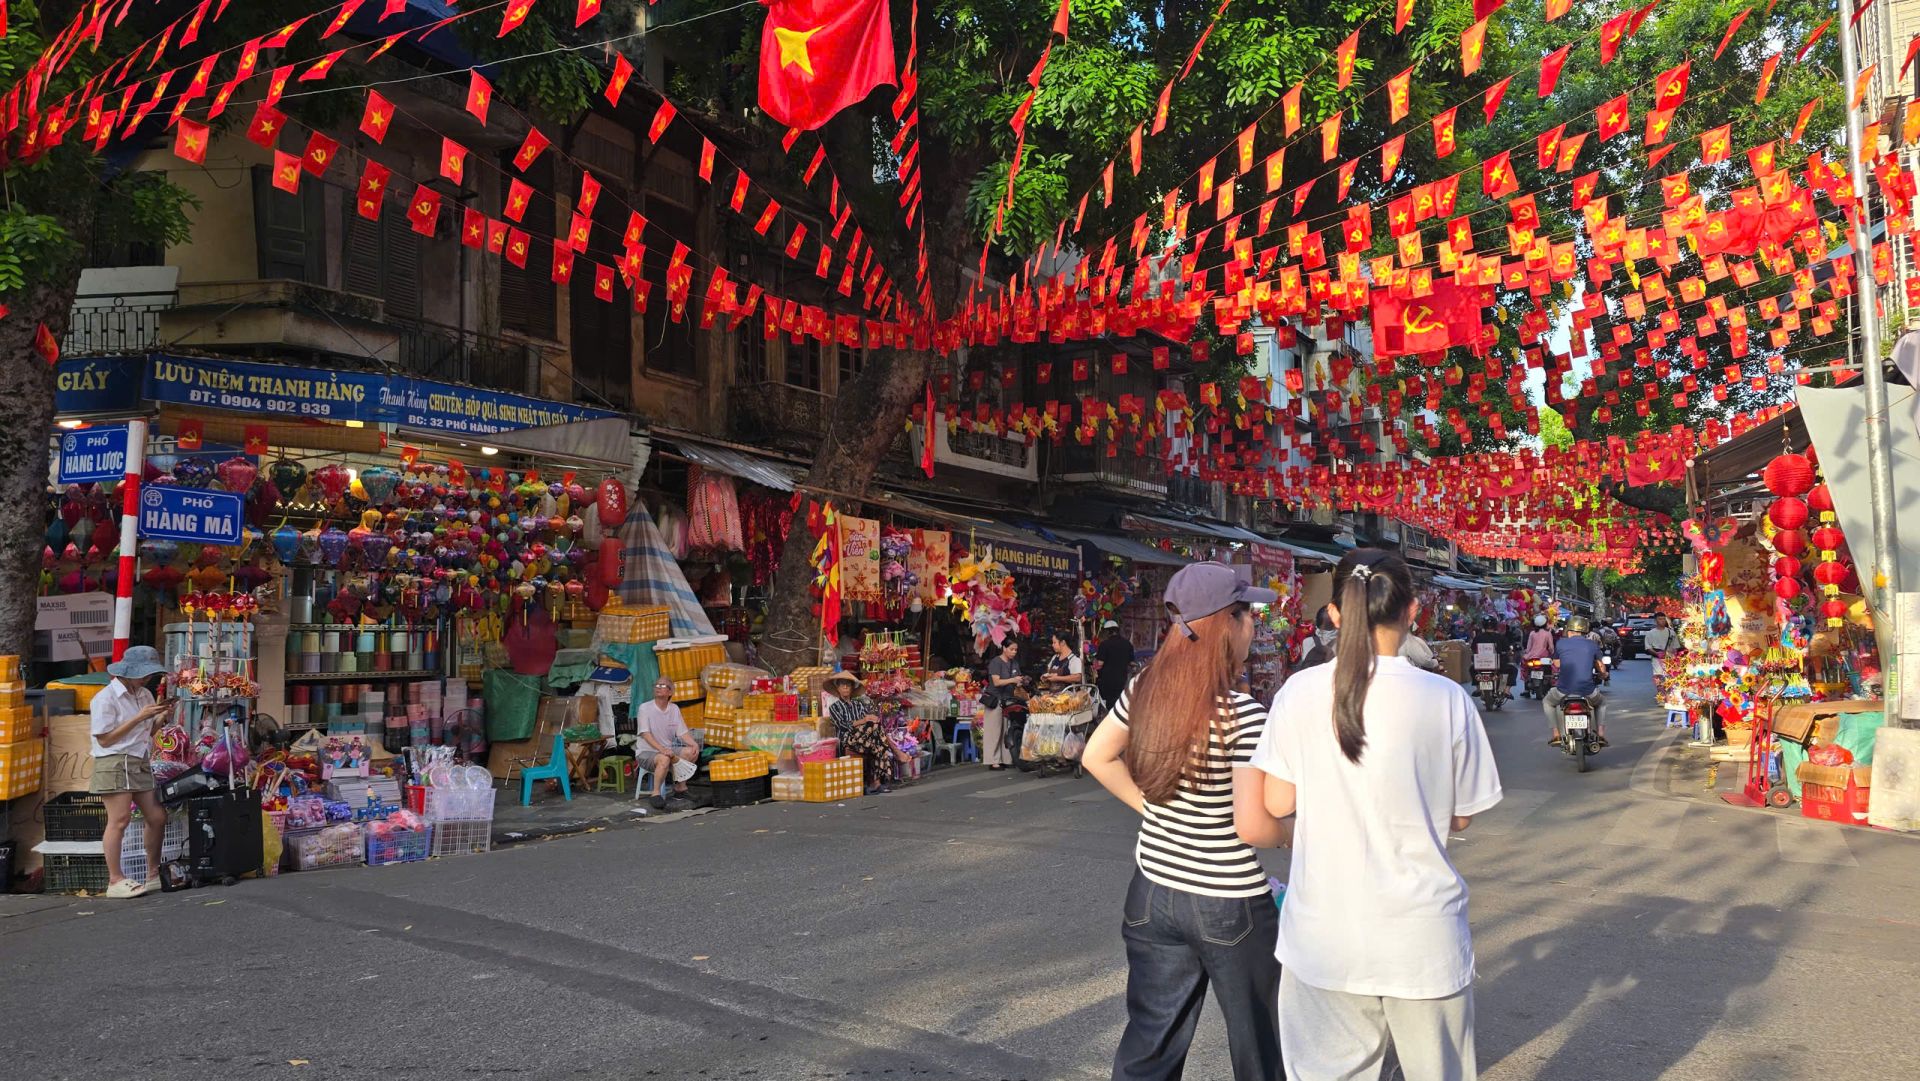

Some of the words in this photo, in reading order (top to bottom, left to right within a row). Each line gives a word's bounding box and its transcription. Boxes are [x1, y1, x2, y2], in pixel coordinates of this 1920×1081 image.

[57, 362, 111, 392] GIẤY
[155, 360, 195, 384] LƯU
[198, 368, 244, 394] NIỆM
[248, 375, 312, 398] THANH
[315, 371, 366, 403] HẰNG
[190, 389, 218, 404] ĐT:
[221, 394, 262, 409] 0904
[266, 399, 297, 413] 902
[301, 402, 331, 416] 939
[379, 386, 406, 408] Thanh
[428, 391, 464, 415] CHUYÊN:
[465, 394, 481, 421] HỘP
[481, 398, 497, 422] QUÀ
[499, 403, 517, 423] SINH
[517, 404, 538, 429] NHẬT
[408, 414, 427, 426] ĐC:
[429, 417, 444, 429] 32
[445, 418, 468, 431] PHỐ
[469, 421, 498, 434] HÀNG
[87, 432, 109, 446] PHỐ
[65, 450, 94, 474] HÀNG
[96, 450, 124, 475] LƯỢC
[182, 495, 214, 509] PHỐ
[146, 507, 198, 533] HÀNG
[204, 514, 233, 536] MÃ
[995, 546, 1024, 565] HÀNG
[1051, 557, 1070, 571] LAN
